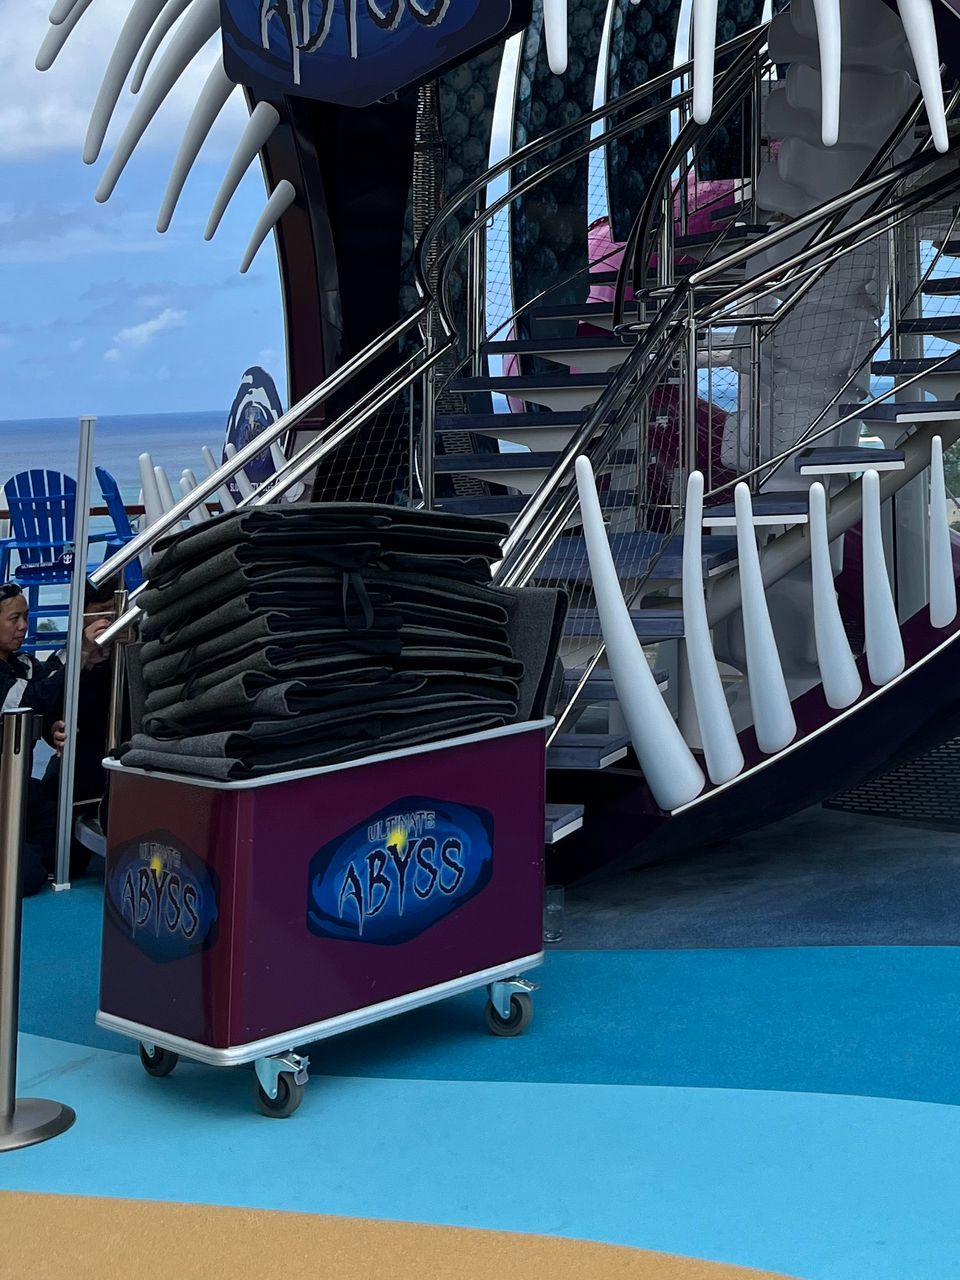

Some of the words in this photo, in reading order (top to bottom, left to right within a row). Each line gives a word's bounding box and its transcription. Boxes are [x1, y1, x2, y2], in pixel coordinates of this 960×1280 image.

[368, 811, 435, 842] ULTIMATE
[122, 867, 198, 938] ABYSS
[338, 836, 465, 936] ABYSS
